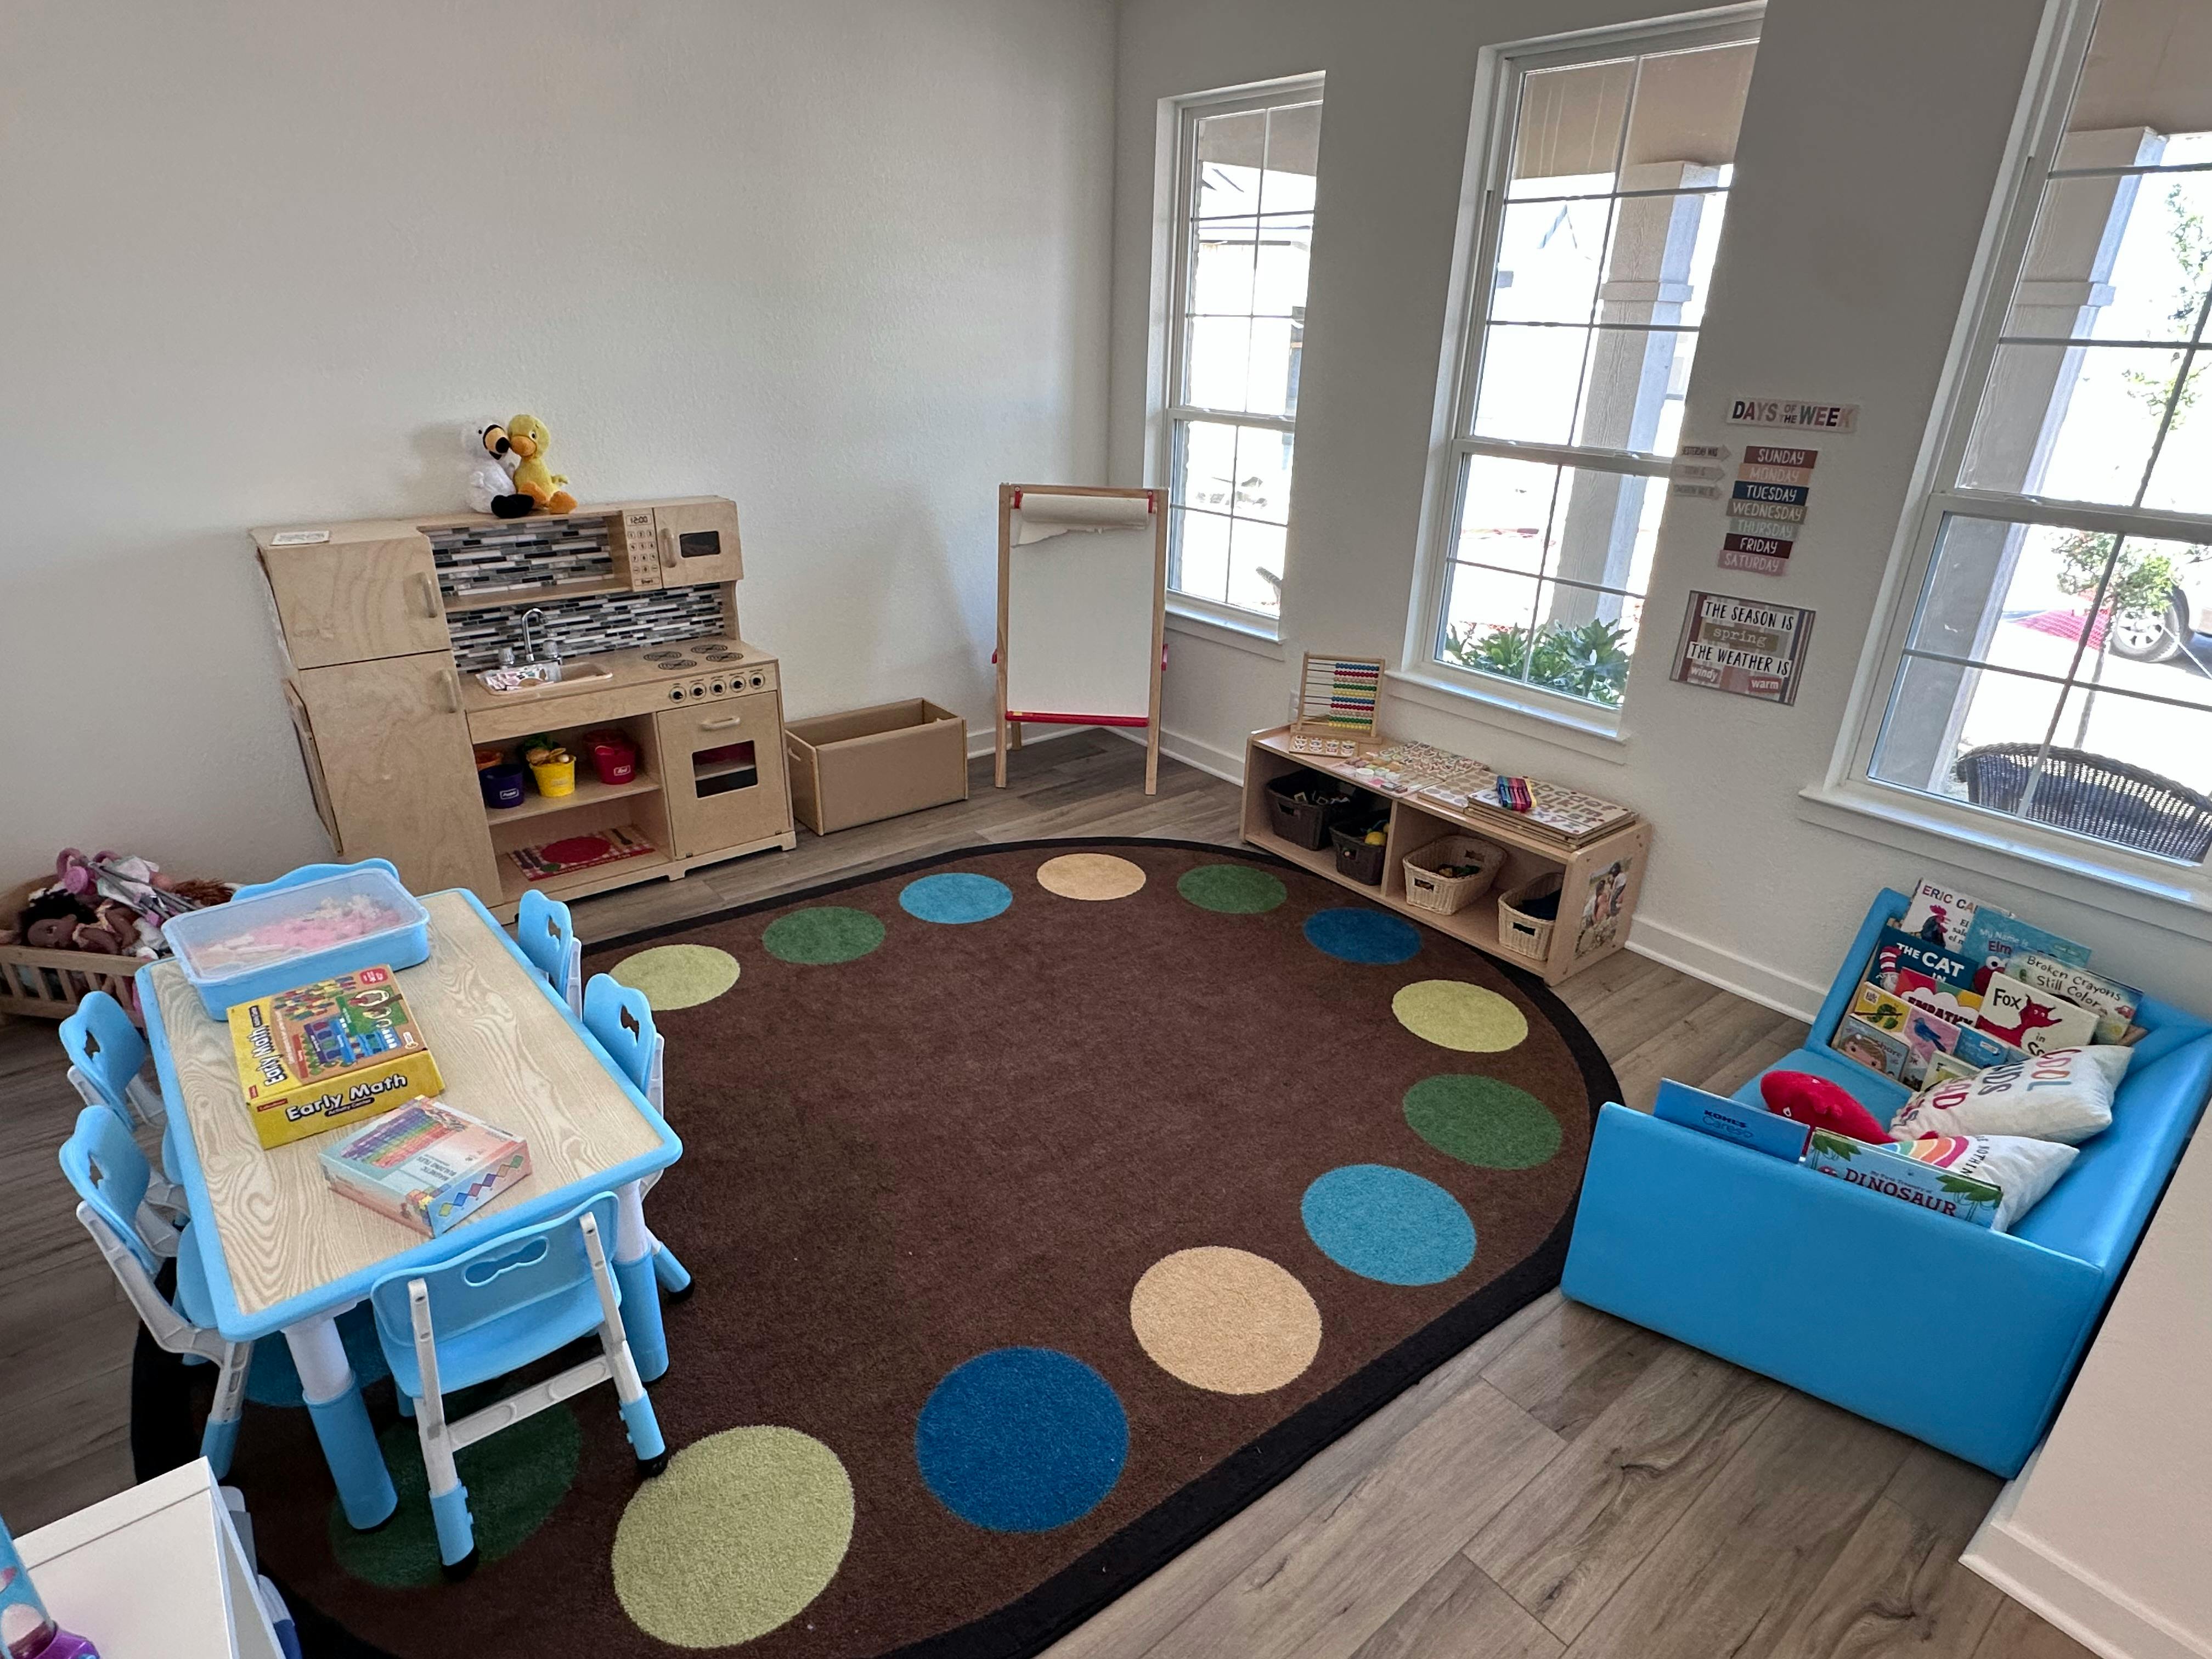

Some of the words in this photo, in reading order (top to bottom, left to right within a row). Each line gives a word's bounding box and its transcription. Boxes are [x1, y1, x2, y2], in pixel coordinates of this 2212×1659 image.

[1732, 400, 1778, 422] DAYS
[1784, 404, 1797, 413] OF
[1799, 405, 1854, 428] WEEK
[1781, 414, 1797, 424] THE
[1758, 448, 1805, 464] SUNDAY
[1749, 467, 1800, 483] MONDAY
[1747, 484, 1797, 502] TUESDAY
[1733, 501, 1803, 521] WEDNESDAY
[1738, 519, 1793, 539] THURSDAY
[1740, 537, 1779, 554] FRIDAY
[1724, 554, 1780, 573] SATURDAY
[1705, 602, 1728, 618] THE
[1731, 606, 1777, 628] SEASON
[1782, 616, 1794, 631] IS
[1713, 628, 1768, 648] spring
[1691, 644, 1714, 661] THE
[1717, 648, 1773, 673] WEATHER
[1776, 660, 1790, 676] IS
[1691, 666, 1718, 682] windy
[1751, 678, 1779, 690] warm
[1922, 884, 1953, 904] ERIC
[1960, 919, 1970, 927] El
[1896, 943, 1921, 960] THE
[1988, 940, 2013, 956] Elm
[1922, 951, 1965, 978] CAT
[2027, 956, 2068, 980] Broken
[2072, 975, 2121, 1002] Crayons
[1993, 988, 2022, 1010] Fox
[2036, 975, 2064, 991] Still
[2067, 985, 2101, 1007] Color
[247, 1024, 276, 1058] Math
[2035, 1032, 2046, 1043] in
[262, 1054, 288, 1087] Early
[285, 1094, 343, 1122] Early
[349, 1074, 408, 1102] Math
[1959, 1144, 1990, 1175] NOTHIN
[1843, 1167, 1957, 1218] DINOSAUR
